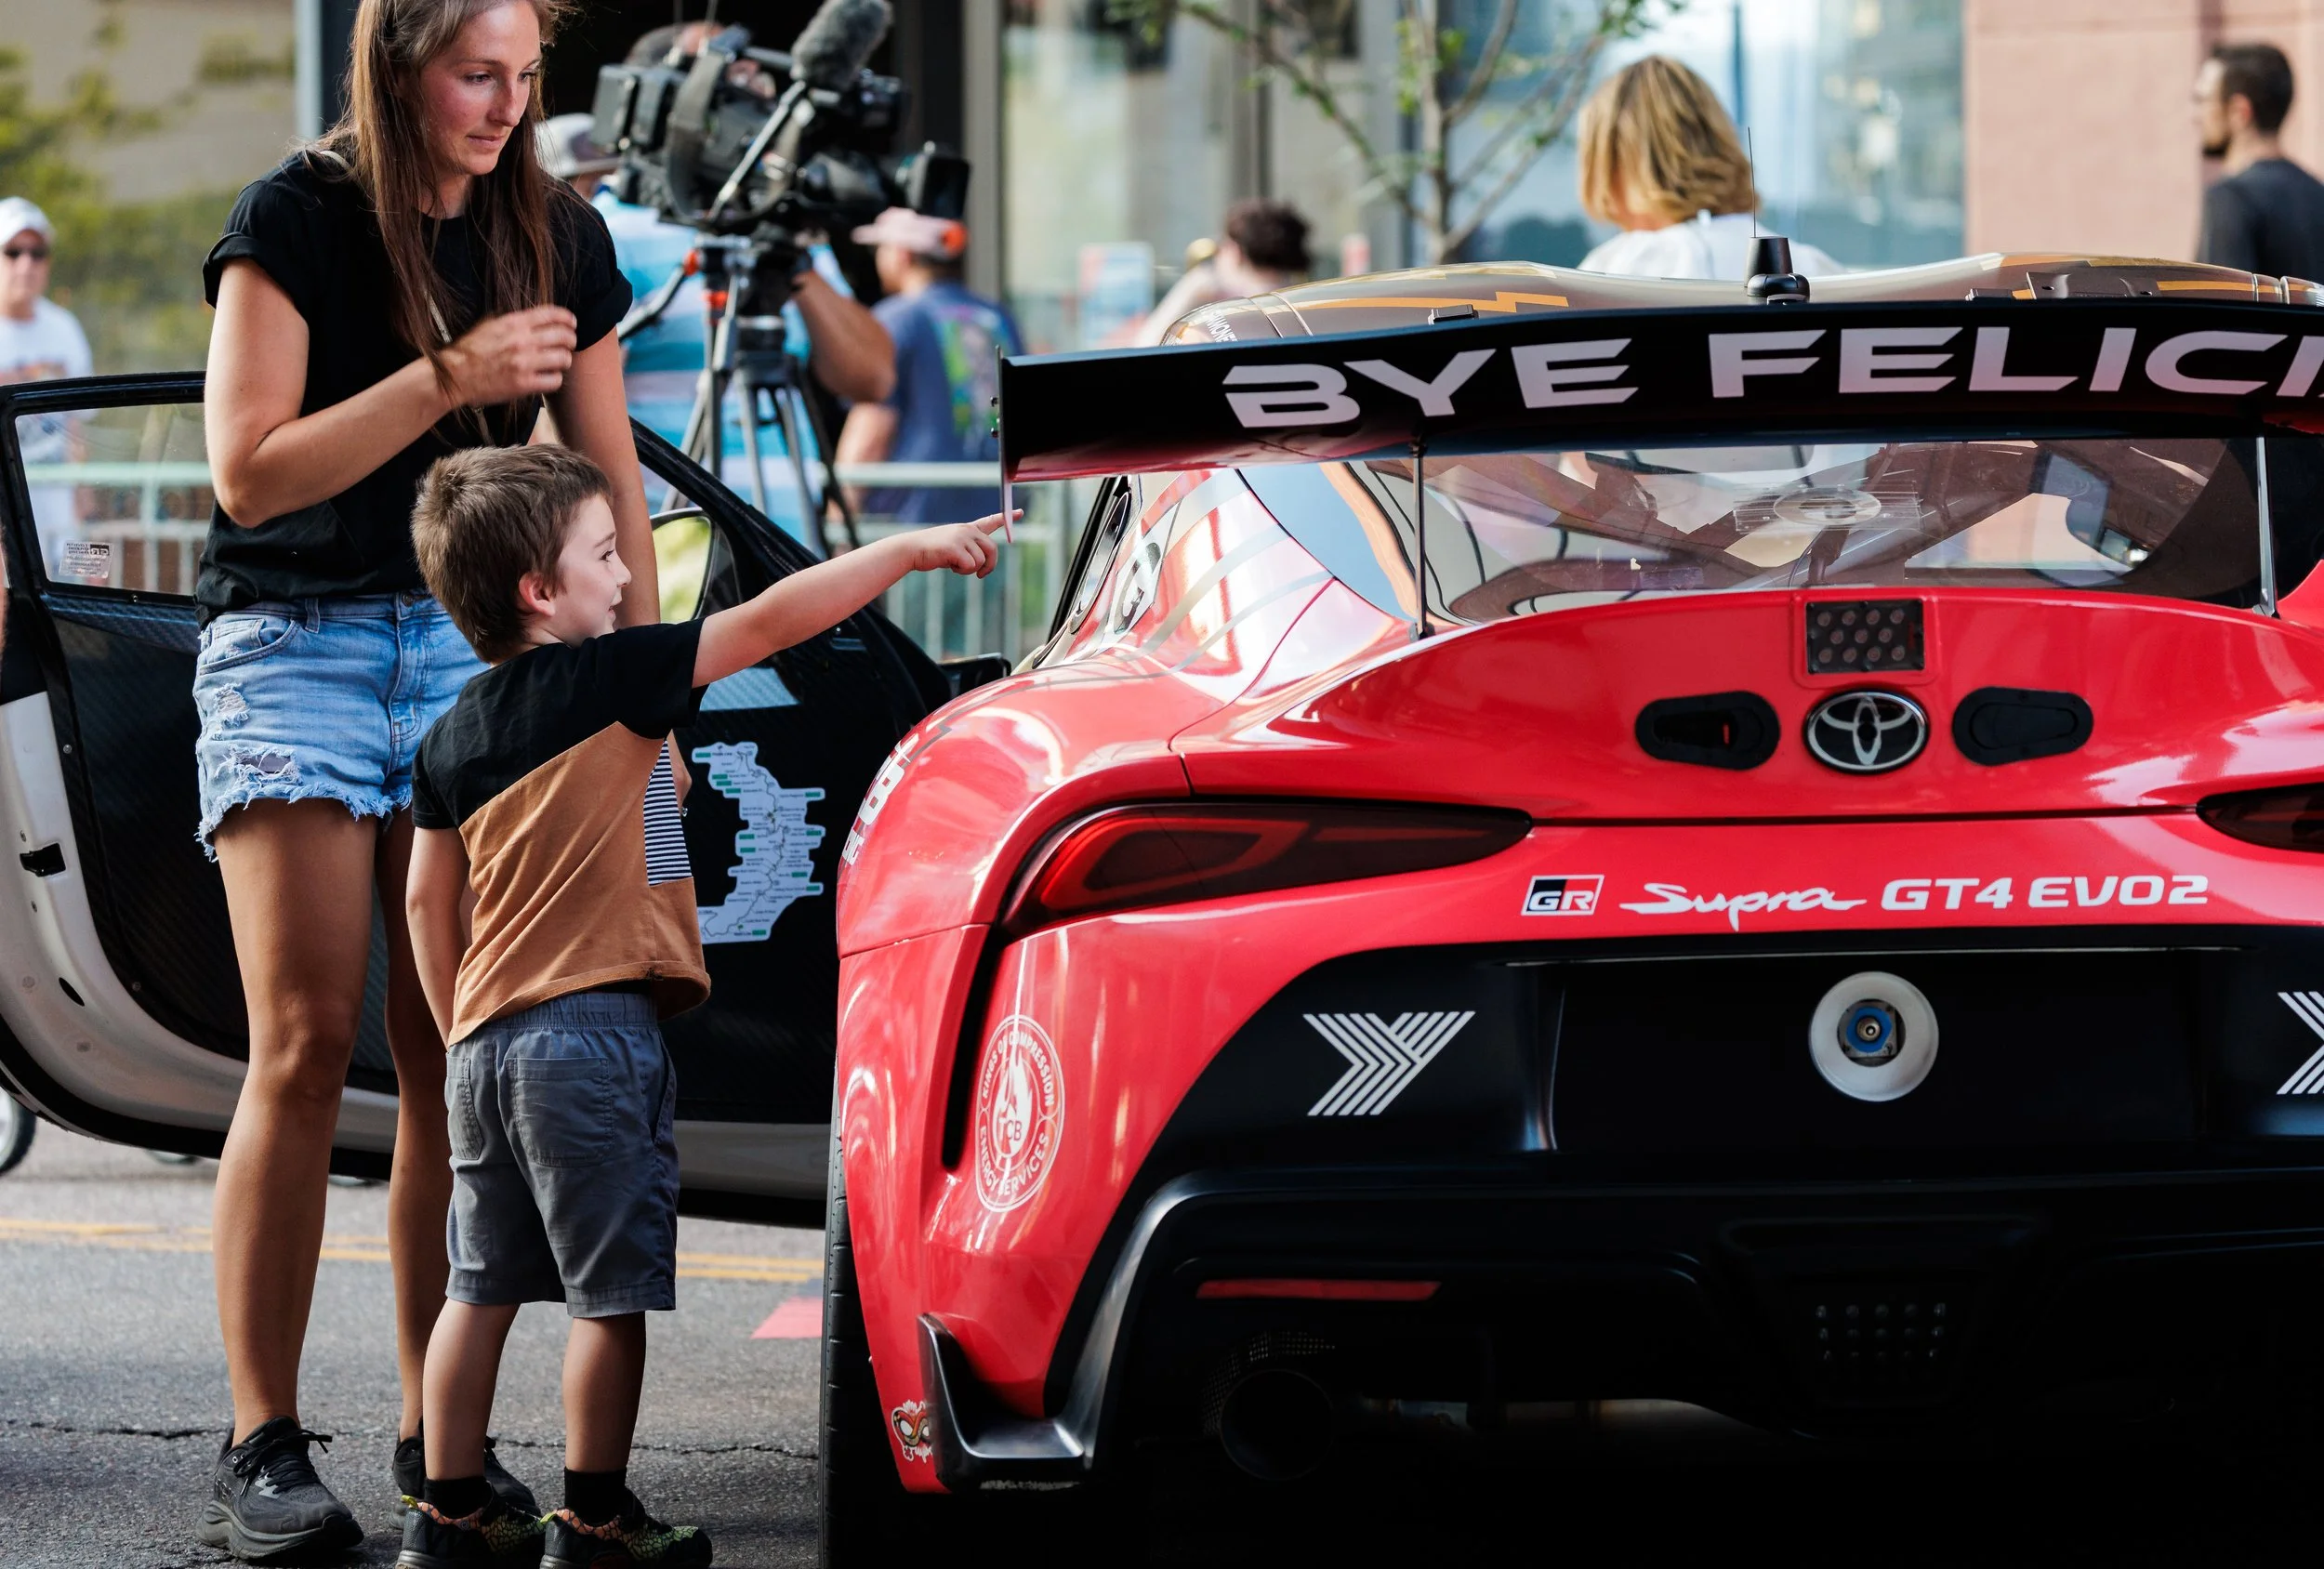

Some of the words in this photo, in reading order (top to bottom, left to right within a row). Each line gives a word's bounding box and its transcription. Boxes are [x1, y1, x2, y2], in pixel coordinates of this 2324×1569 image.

[1221, 338, 1640, 429] BYE
[1709, 326, 2324, 398] FELICI
[1527, 890, 1594, 912] GR
[1618, 882, 1868, 932] Supra
[1881, 877, 2014, 911] GT4
[2027, 875, 2209, 909] EVO2
[982, 1049, 998, 1099] KINGS
[1009, 1030, 1055, 1108] COMPRESSION
[980, 1125, 1000, 1193] ENERGY
[997, 1132, 1050, 1196] SERVICES
[998, 1117, 1023, 1141] TCB
